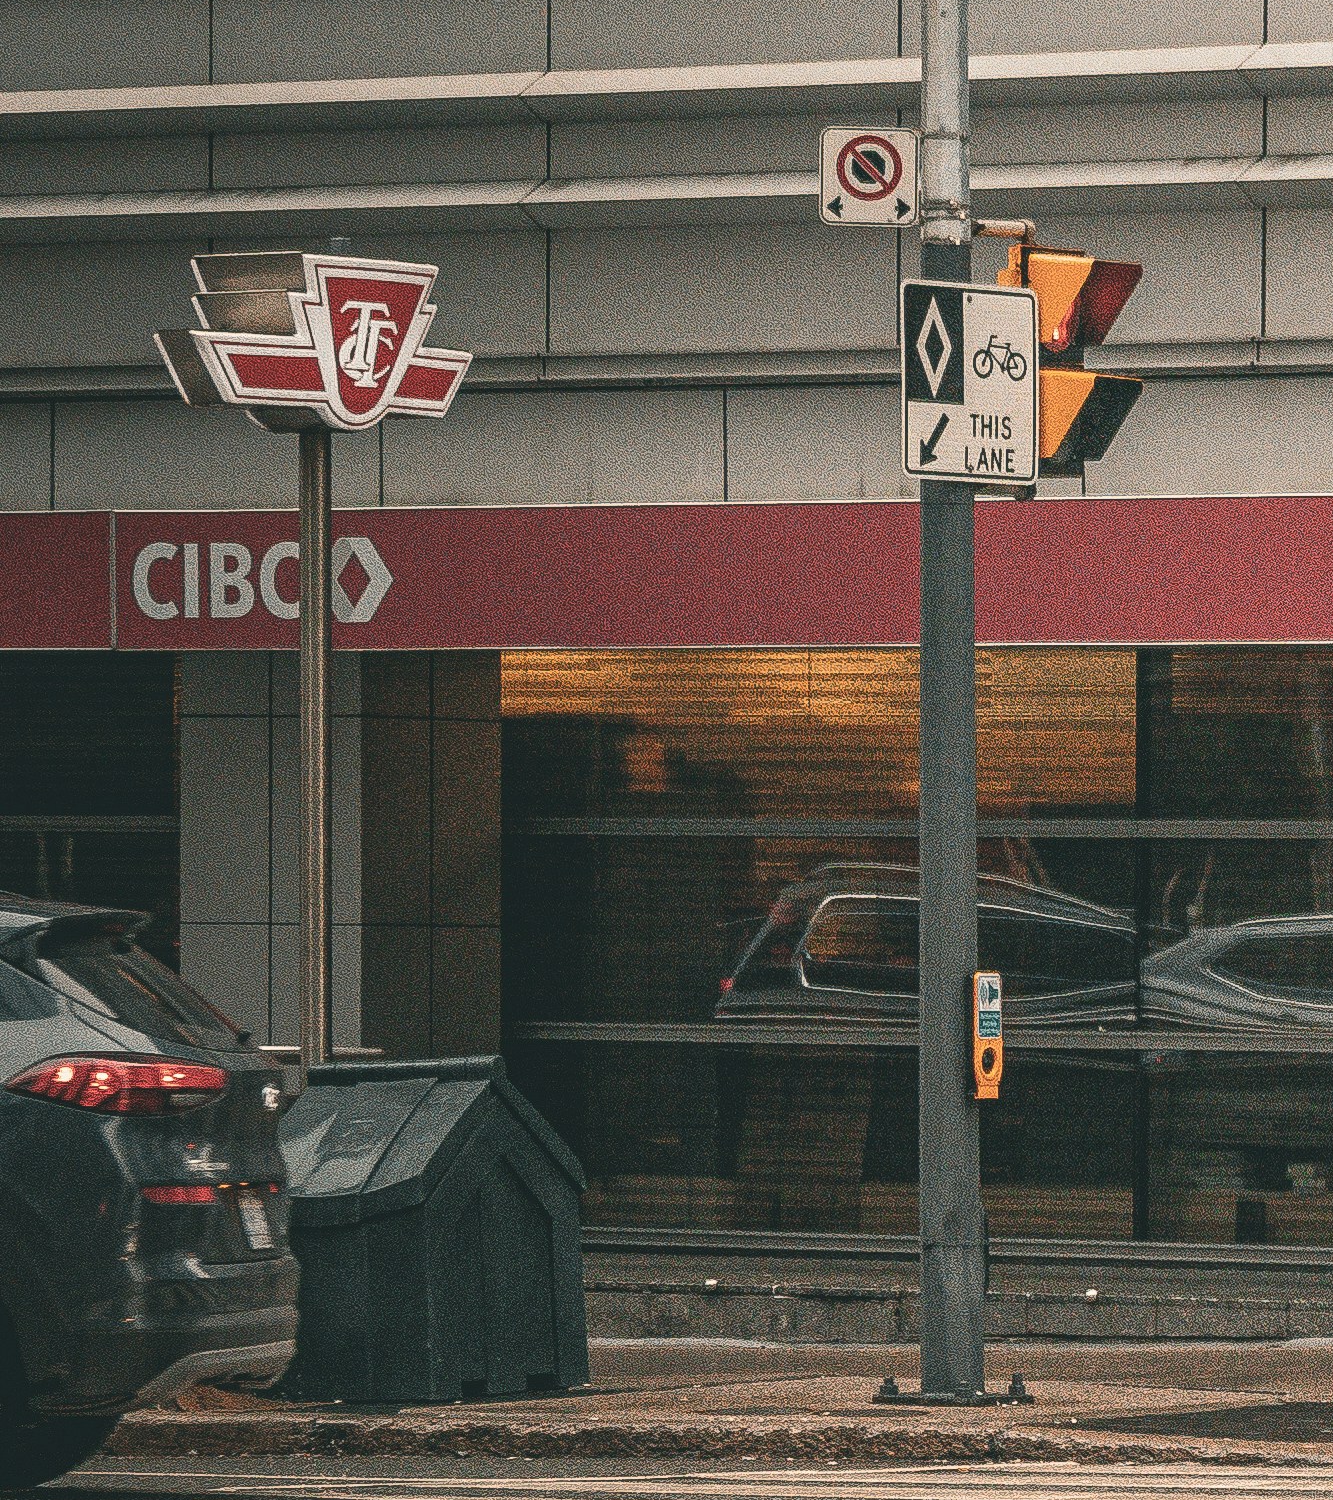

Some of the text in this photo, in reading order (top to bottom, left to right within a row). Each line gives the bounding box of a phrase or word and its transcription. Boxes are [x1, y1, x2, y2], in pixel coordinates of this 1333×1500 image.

[969, 413, 1012, 440] THIS
[964, 445, 1016, 474] LANE
[131, 541, 300, 620] CIBC
